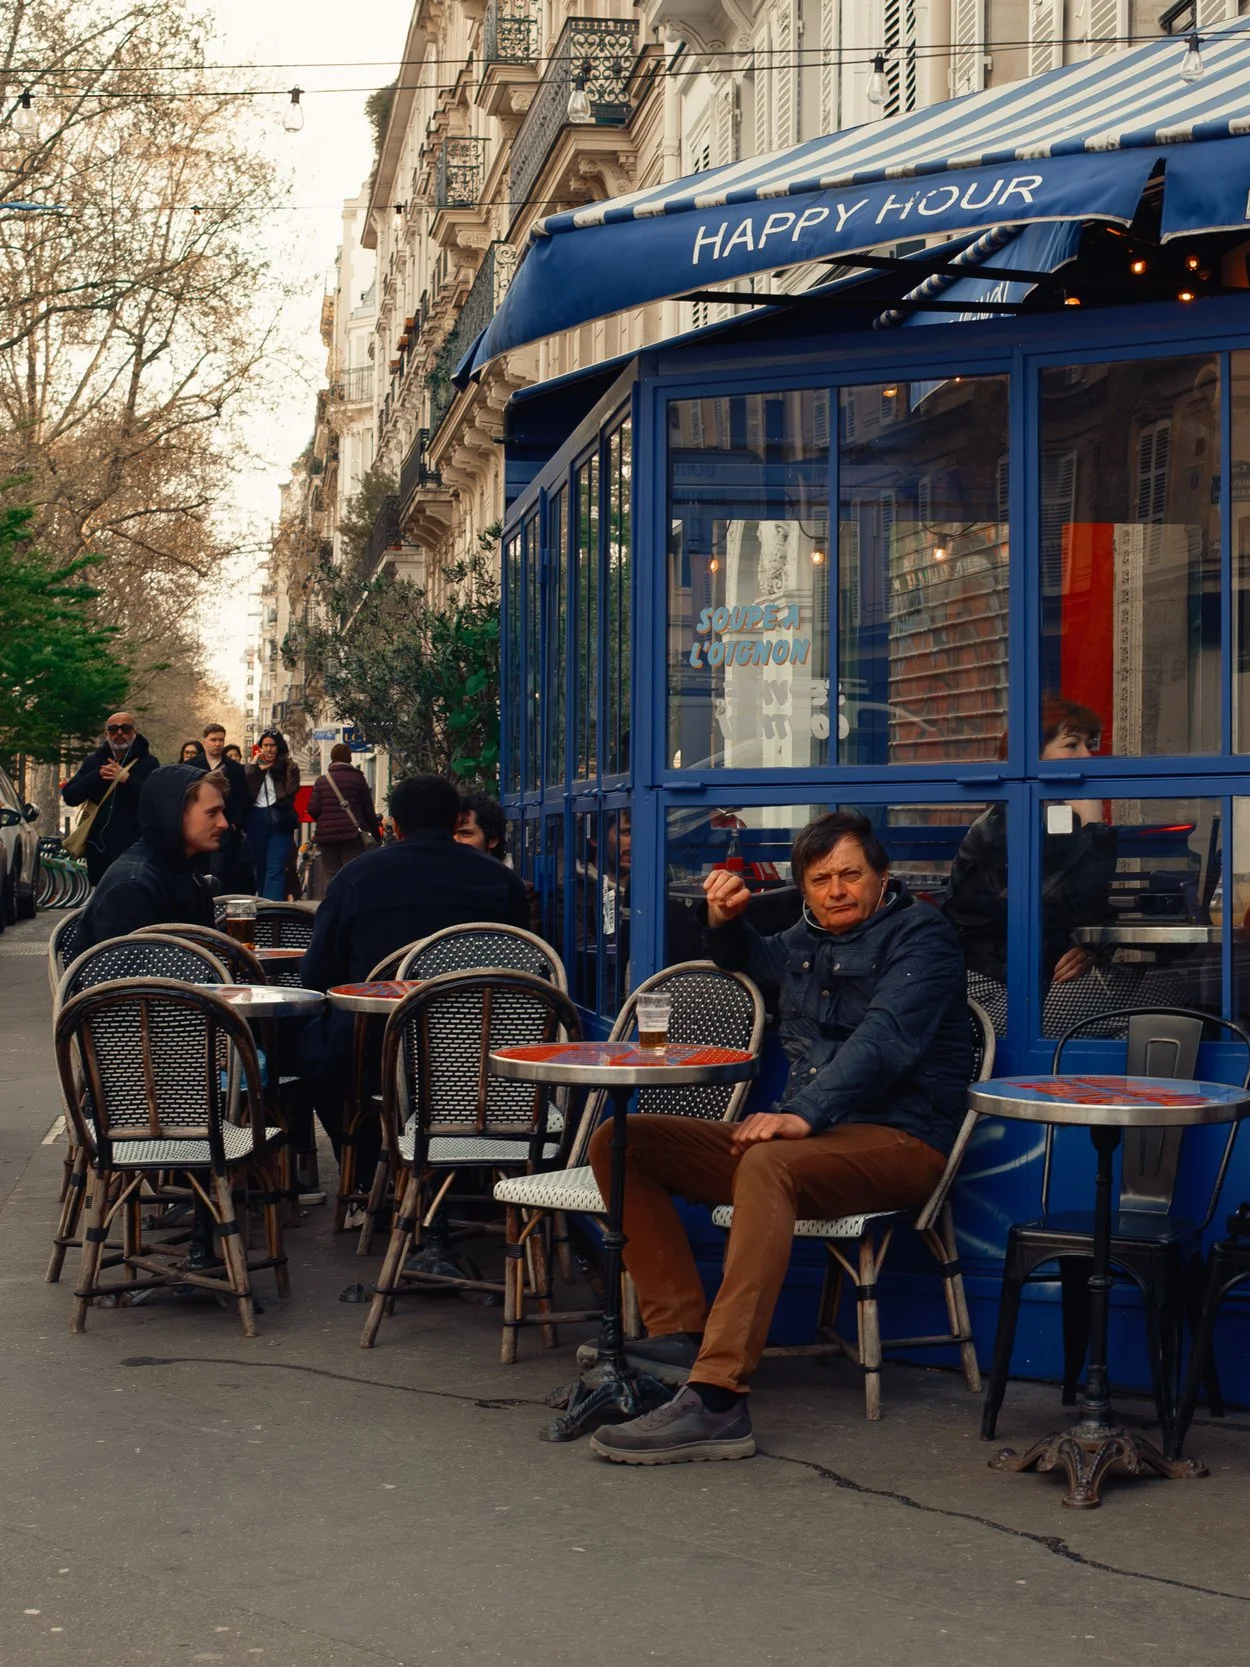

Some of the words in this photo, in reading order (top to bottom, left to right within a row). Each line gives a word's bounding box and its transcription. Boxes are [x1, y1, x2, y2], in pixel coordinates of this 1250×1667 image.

[692, 198, 869, 265] HAPPY
[875, 175, 1043, 225] HOUR
[696, 604, 780, 634] SOUPE
[690, 638, 811, 669] L'OIGNON
